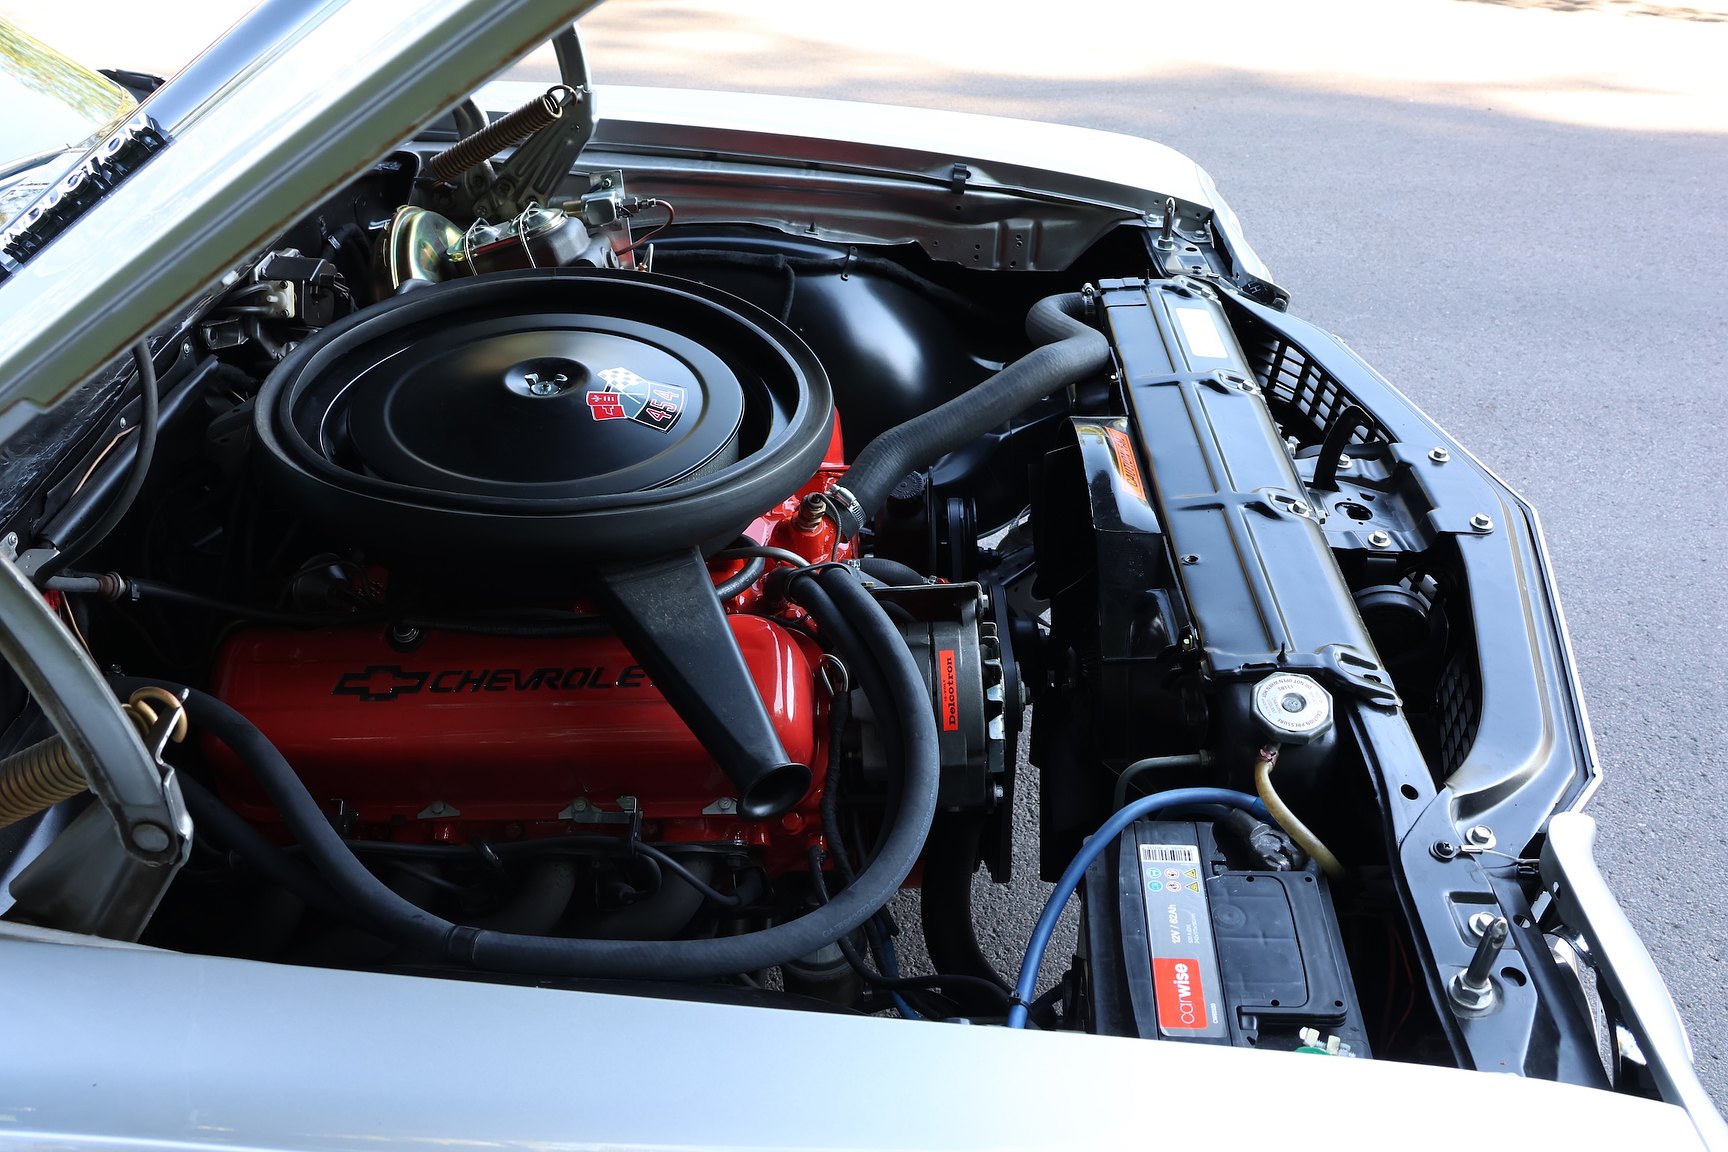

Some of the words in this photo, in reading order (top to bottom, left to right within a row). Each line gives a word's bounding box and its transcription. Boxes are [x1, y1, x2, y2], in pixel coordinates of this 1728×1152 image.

[0, 112, 157, 250] INDUCTION
[645, 388, 680, 422] 454
[428, 664, 652, 693] CHEVROLE
[946, 657, 956, 725] Delcotron
[1277, 718, 1305, 727] PRESSURE
[1168, 904, 1177, 923] 62Ah
[1171, 929, 1180, 944] 12V
[1173, 963, 1195, 1023] carwise
